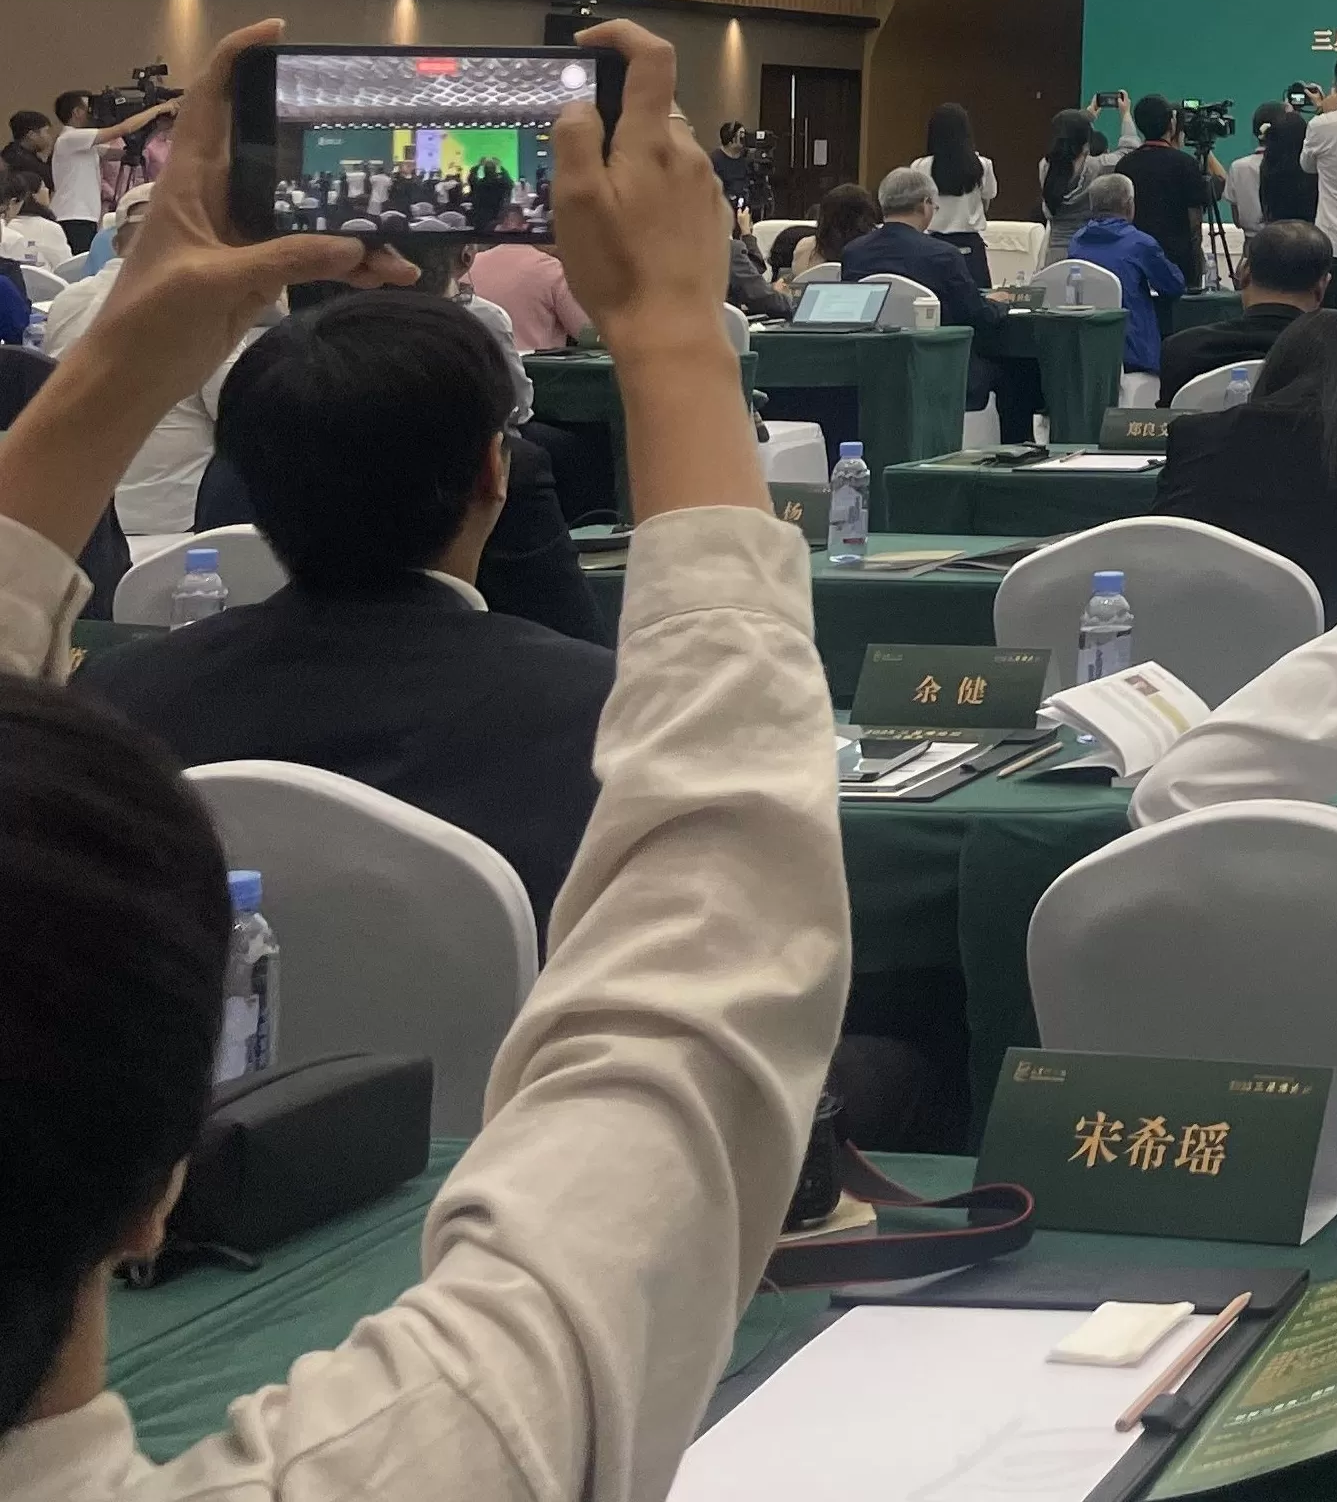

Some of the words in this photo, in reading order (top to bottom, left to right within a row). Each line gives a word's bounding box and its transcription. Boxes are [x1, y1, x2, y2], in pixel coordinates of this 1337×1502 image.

[913, 675, 988, 705] 余健
[1067, 1110, 1231, 1175] 宋希瑶
